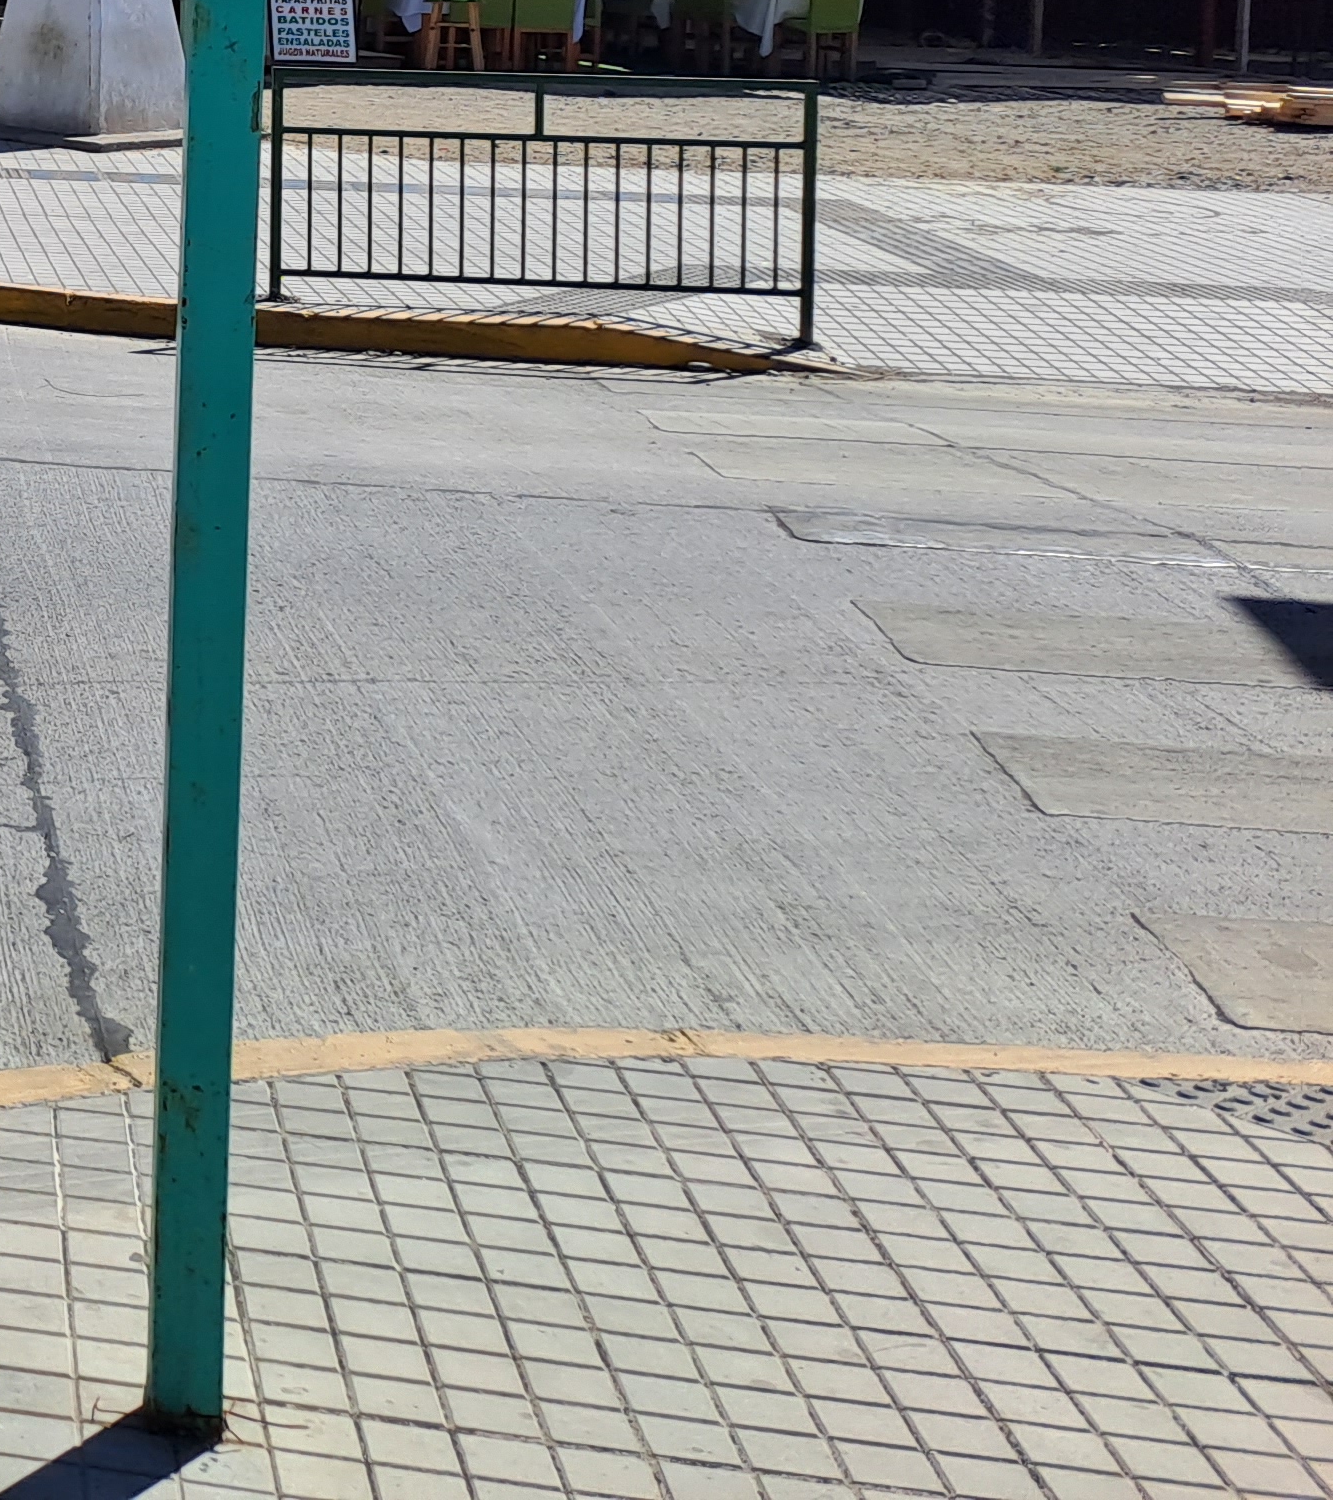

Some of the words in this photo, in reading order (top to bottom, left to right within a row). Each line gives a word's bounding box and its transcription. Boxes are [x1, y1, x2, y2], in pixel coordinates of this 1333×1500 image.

[276, 5, 348, 16] CARNES
[277, 16, 350, 26] BATIDOS
[278, 27, 350, 38] PASTELES
[278, 37, 350, 48] ENSALADAS
[305, 48, 350, 58] NATURALES
